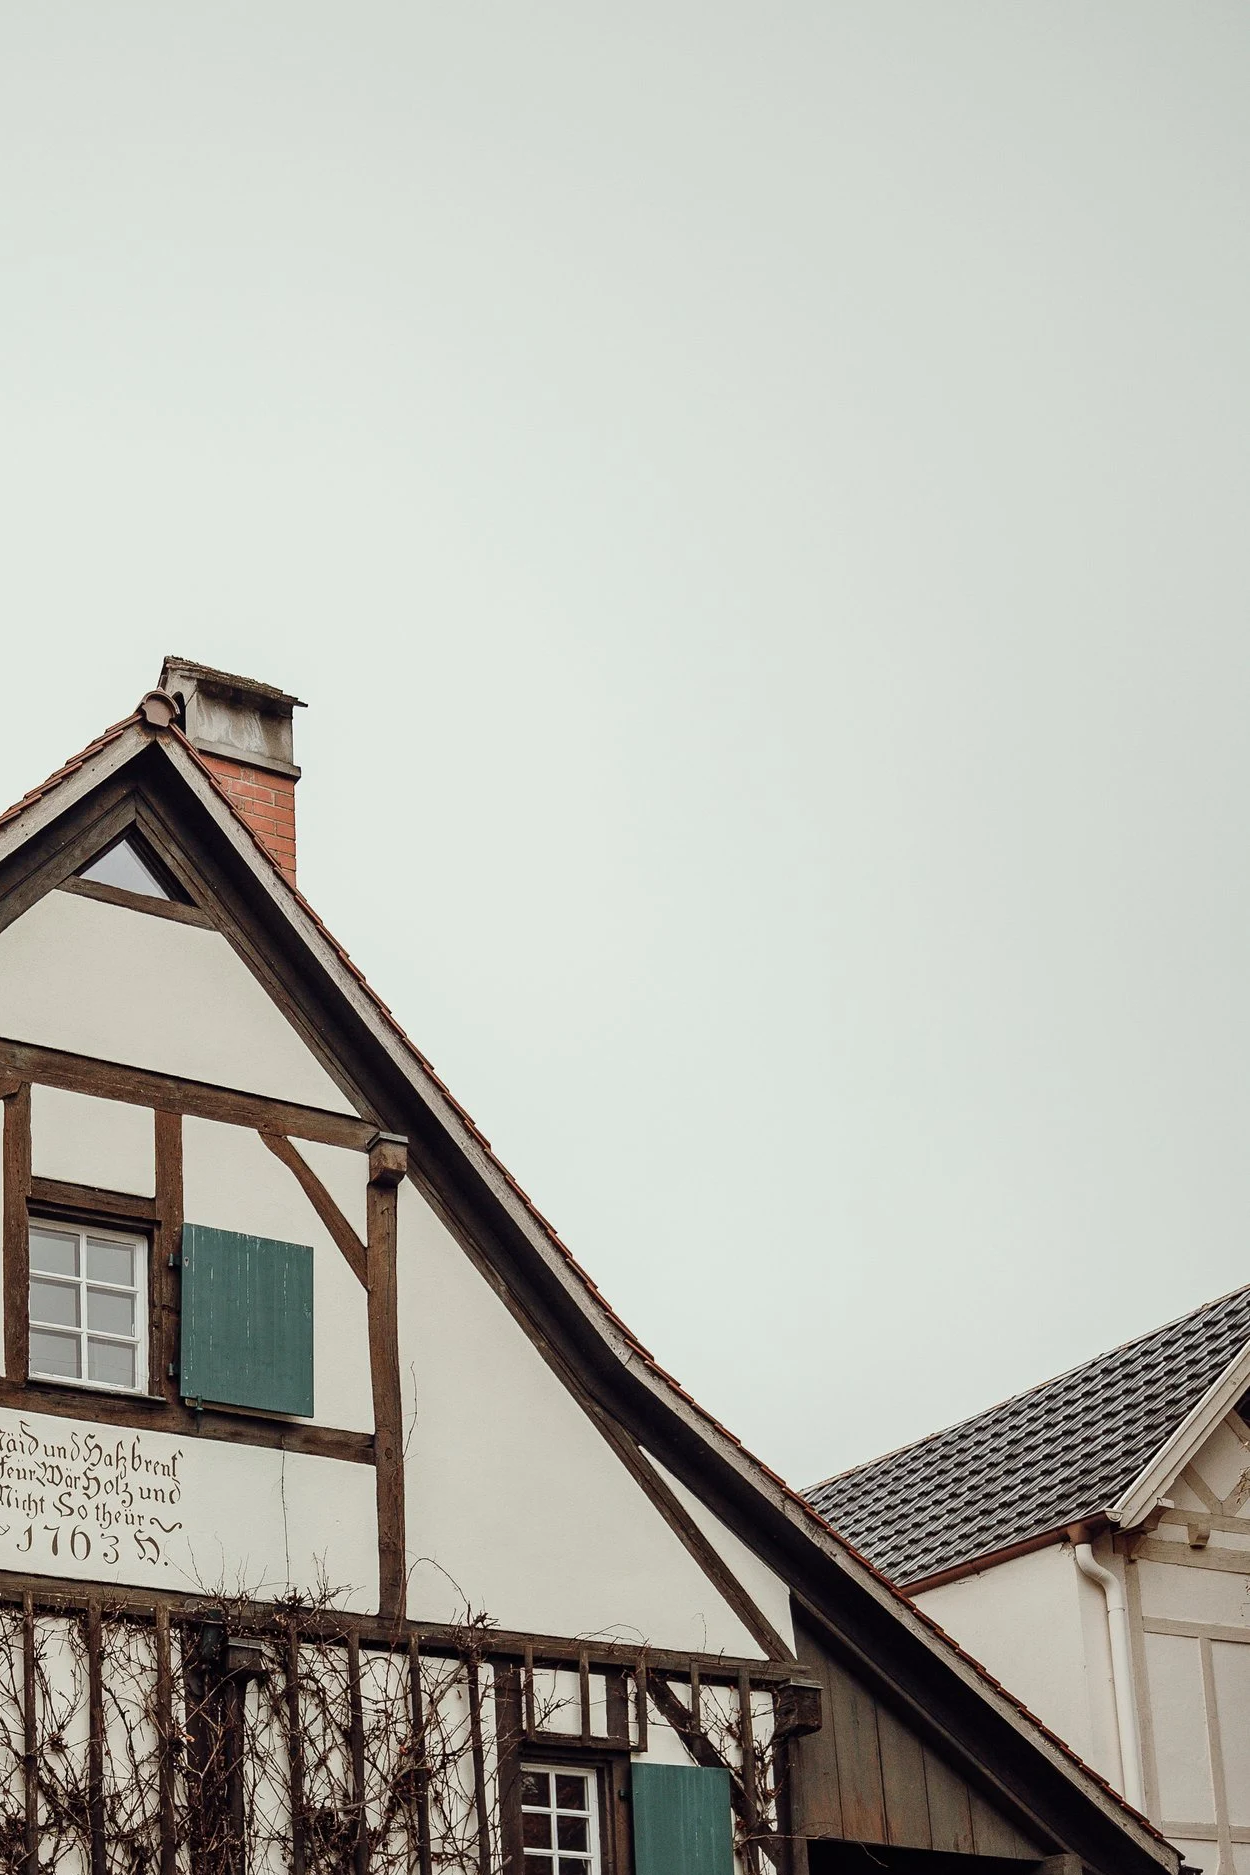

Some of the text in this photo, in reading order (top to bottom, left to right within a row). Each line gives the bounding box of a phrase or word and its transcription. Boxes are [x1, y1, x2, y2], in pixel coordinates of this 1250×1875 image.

[43, 1431, 80, 1461] und
[83, 1466, 134, 1508] Holz
[139, 1479, 181, 1505] und
[53, 1491, 88, 1521] So
[16, 1524, 120, 1565] 1763
